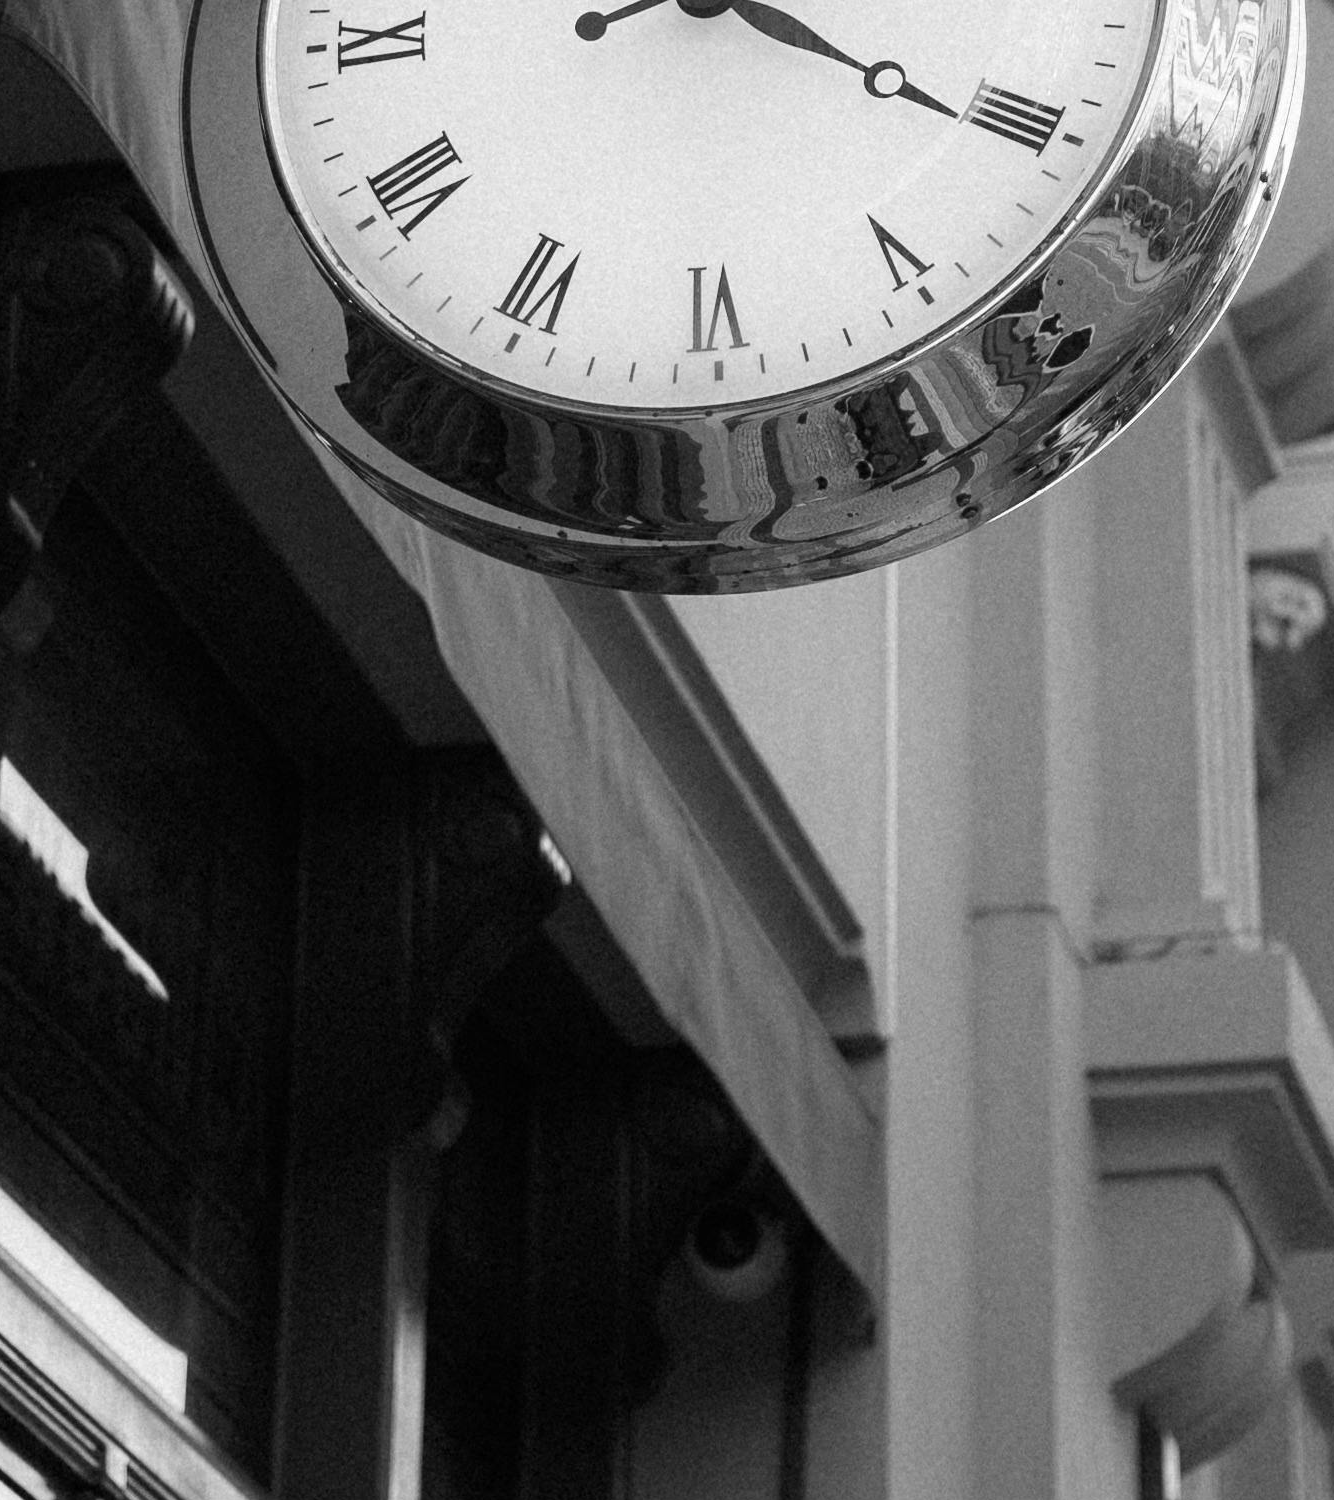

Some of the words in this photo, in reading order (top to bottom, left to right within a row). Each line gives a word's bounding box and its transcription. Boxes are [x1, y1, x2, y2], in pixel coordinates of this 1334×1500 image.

[336, 9, 427, 75] IX
[957, 76, 1067, 158] IIII
[365, 129, 474, 243] VIII
[492, 231, 584, 336] VII
[866, 213, 935, 293] V
[686, 262, 751, 354] VI
